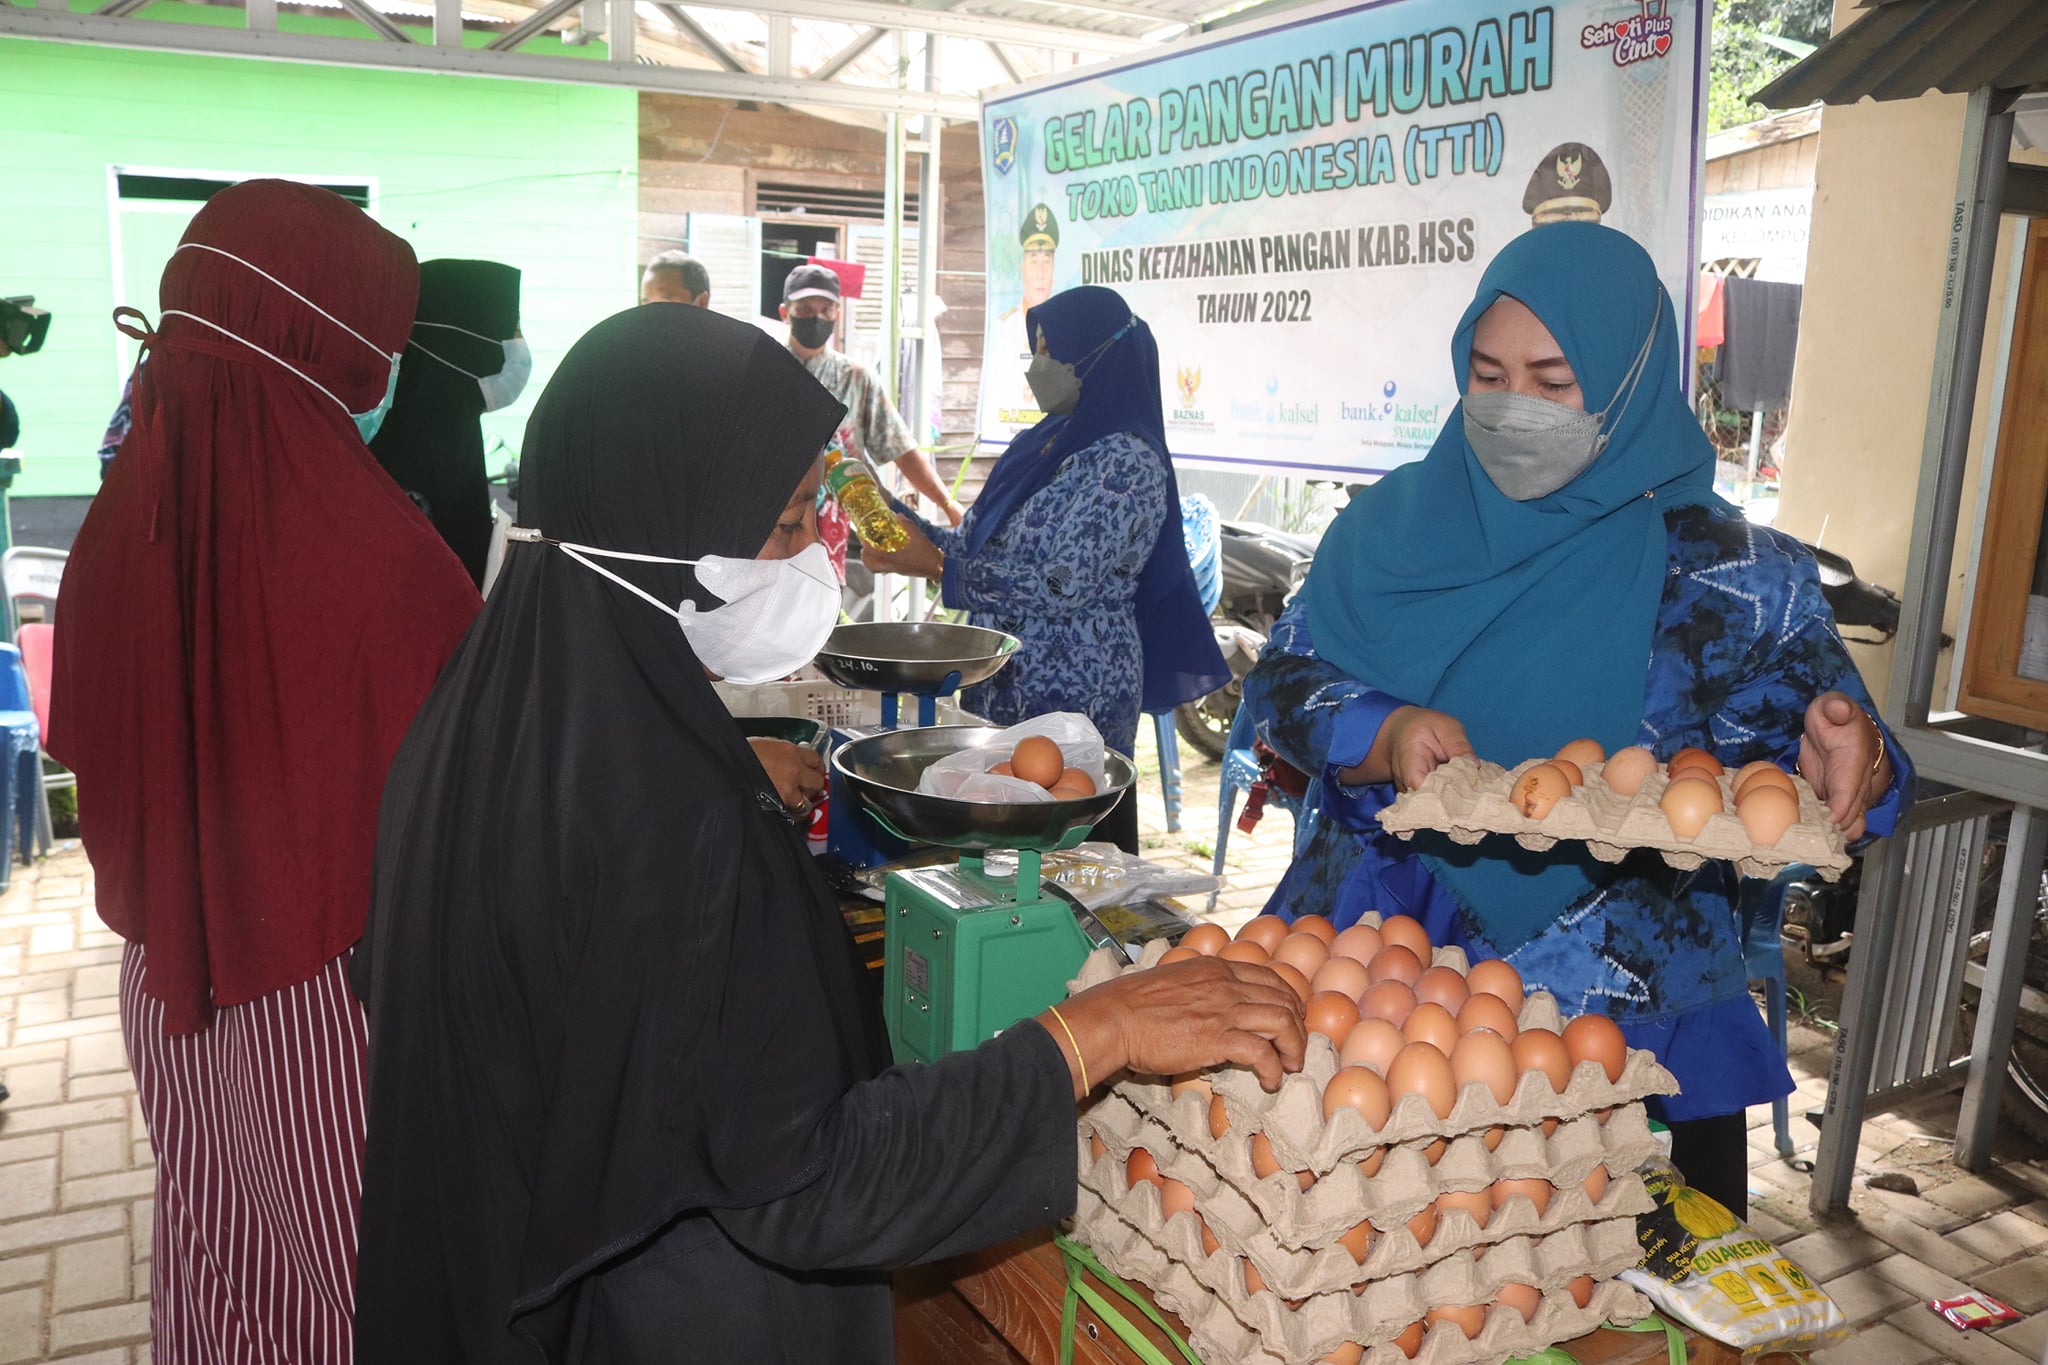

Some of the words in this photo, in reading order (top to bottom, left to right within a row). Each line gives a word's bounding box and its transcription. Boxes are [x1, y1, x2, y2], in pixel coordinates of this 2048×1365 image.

[1645, 18, 1671, 34] Plus
[1044, 97, 1152, 174] GELAR
[1159, 55, 1333, 155] PANGAN
[1345, 6, 1554, 122] MURAH
[1066, 175, 1138, 222] TOKO
[1139, 163, 1202, 213] TANI
[1209, 134, 1395, 205] INDONESIA
[1403, 111, 1505, 186] (TTI)
[1953, 200, 1966, 233] TASO
[1081, 248, 1134, 285] DINAS
[1138, 238, 1257, 281] KETAHANAN
[1261, 229, 1351, 273] PANGAN
[1358, 217, 1475, 268] KAB.HSS
[1197, 291, 1258, 324] TAHUN
[1260, 289, 1312, 323] 2022
[1173, 409, 1205, 421] BAZNAS
[1279, 402, 1319, 424] kalsel
[1341, 401, 1376, 421] bank
[1394, 403, 1440, 424] kalsel
[1393, 425, 1437, 441] SYARIAH
[1837, 1027, 1848, 1054] TASO
[1640, 1228, 1655, 1241] DUA
[1647, 1238, 1669, 1259] KETAPI
[1666, 1251, 1681, 1263] DUA
